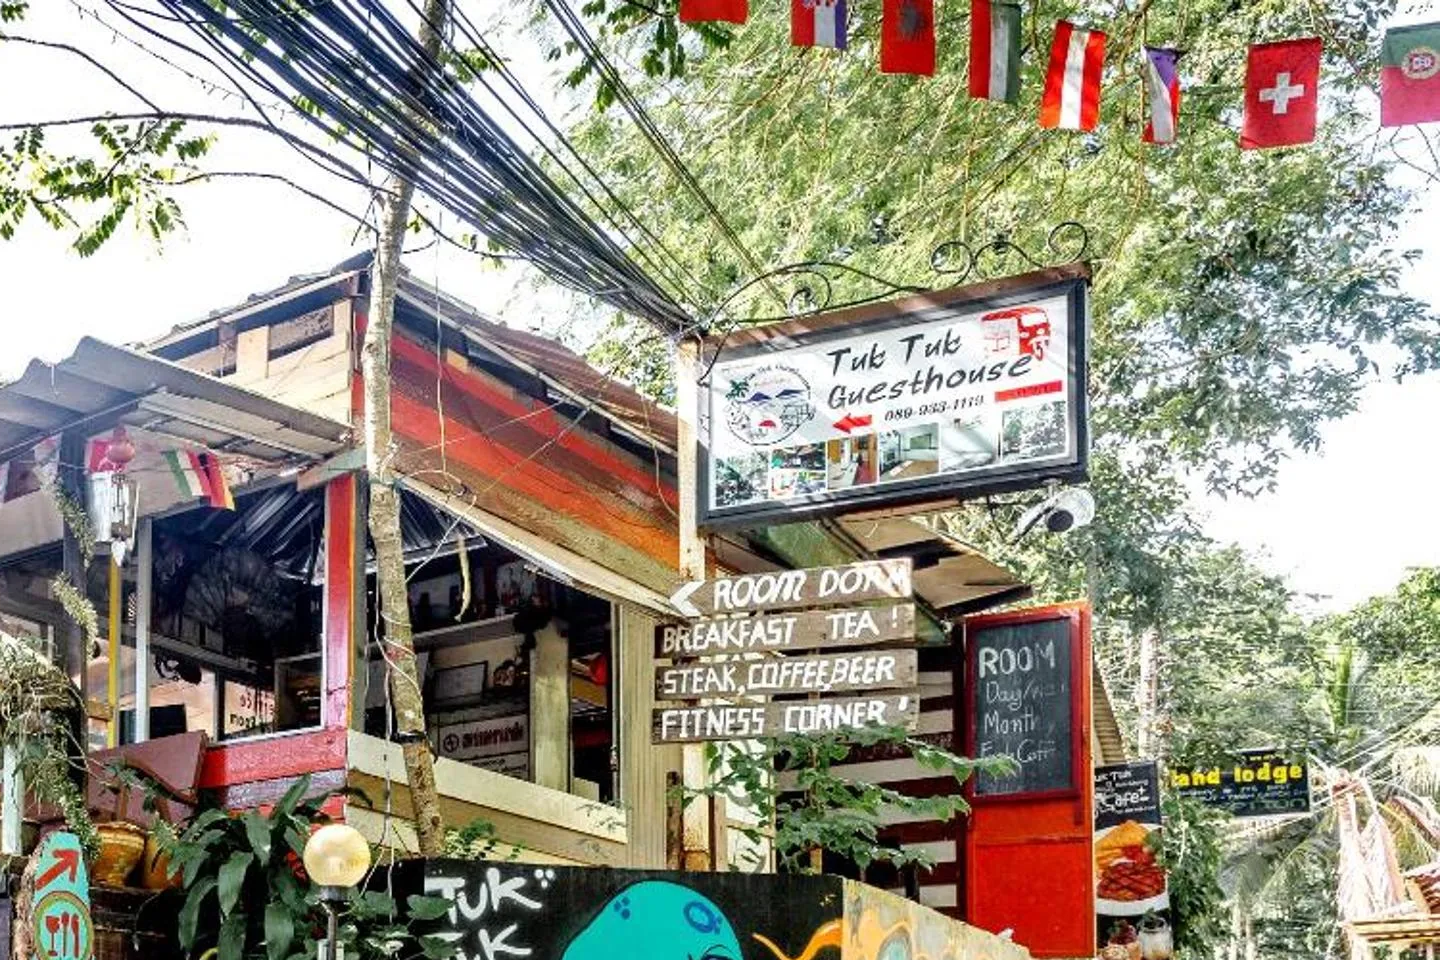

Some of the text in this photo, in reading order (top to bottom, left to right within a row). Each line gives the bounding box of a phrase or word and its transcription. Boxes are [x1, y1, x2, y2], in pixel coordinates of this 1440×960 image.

[827, 328, 962, 376] Tuk Tuk
[828, 355, 1033, 410] Guesthouse
[713, 571, 807, 610] ROOM
[663, 617, 797, 653] BREAKFAST
[978, 639, 1056, 679] ROOM
[661, 700, 887, 740] FITNESS CORNER
[1233, 762, 1302, 784] lodge
[424, 867, 543, 925] TUK
